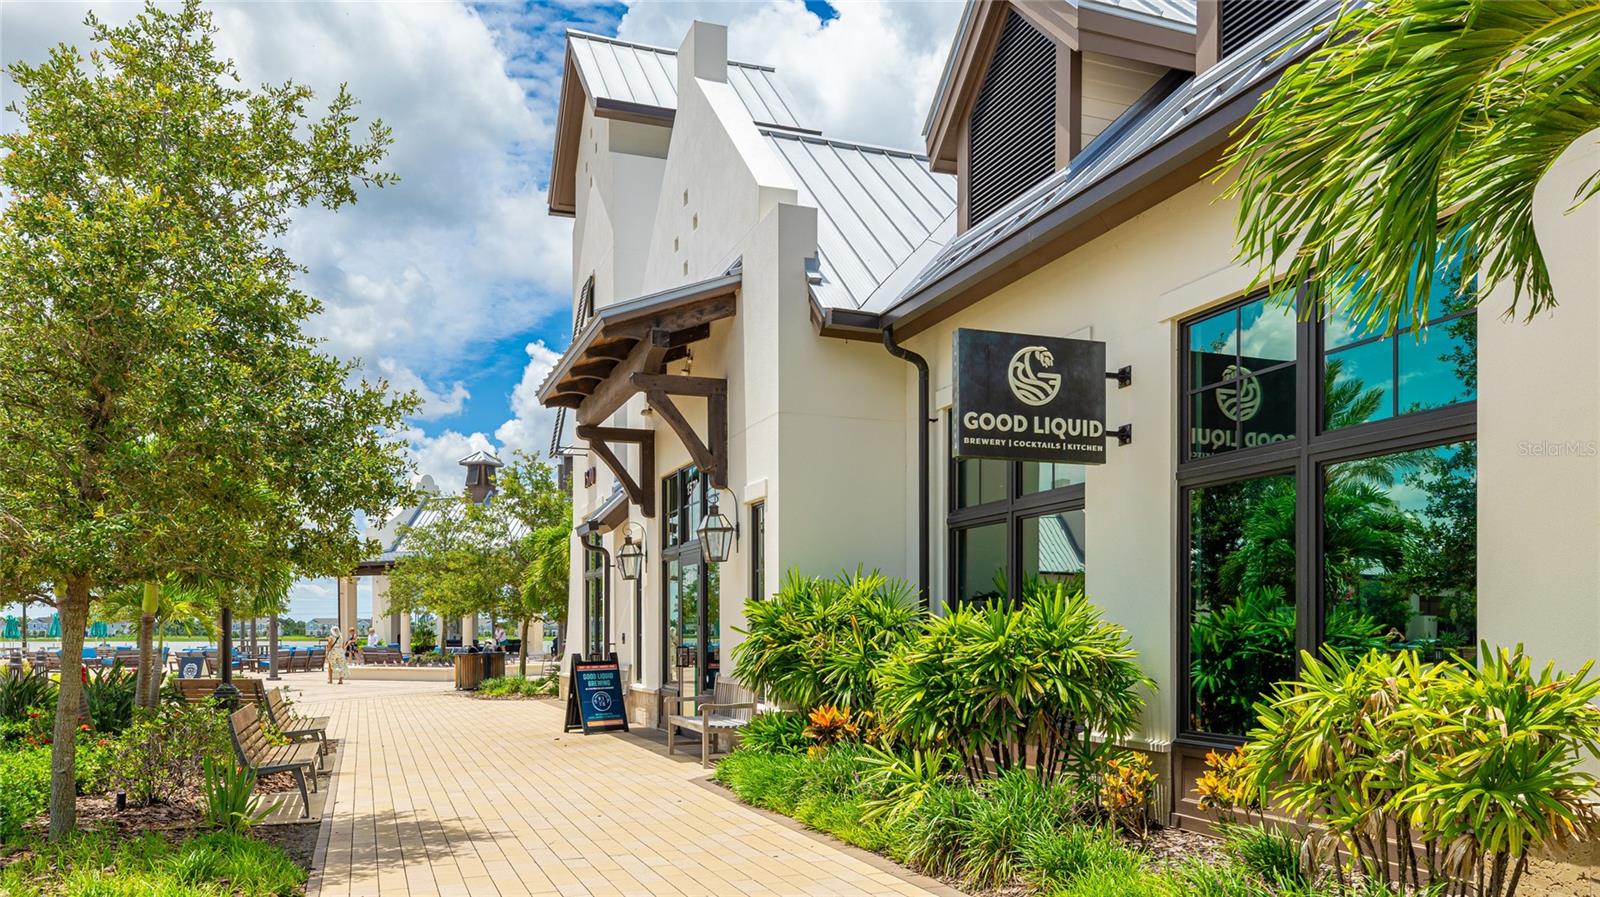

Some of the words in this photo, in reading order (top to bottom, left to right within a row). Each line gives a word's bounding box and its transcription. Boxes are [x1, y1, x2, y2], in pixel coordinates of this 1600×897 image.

[963, 411, 1028, 433] GOOD
[1033, 416, 1103, 440] LIQUID
[963, 437, 1006, 447] BREWERY
[1013, 440, 1061, 449] COCKTAILS
[1067, 444, 1103, 452] KITCHEN
